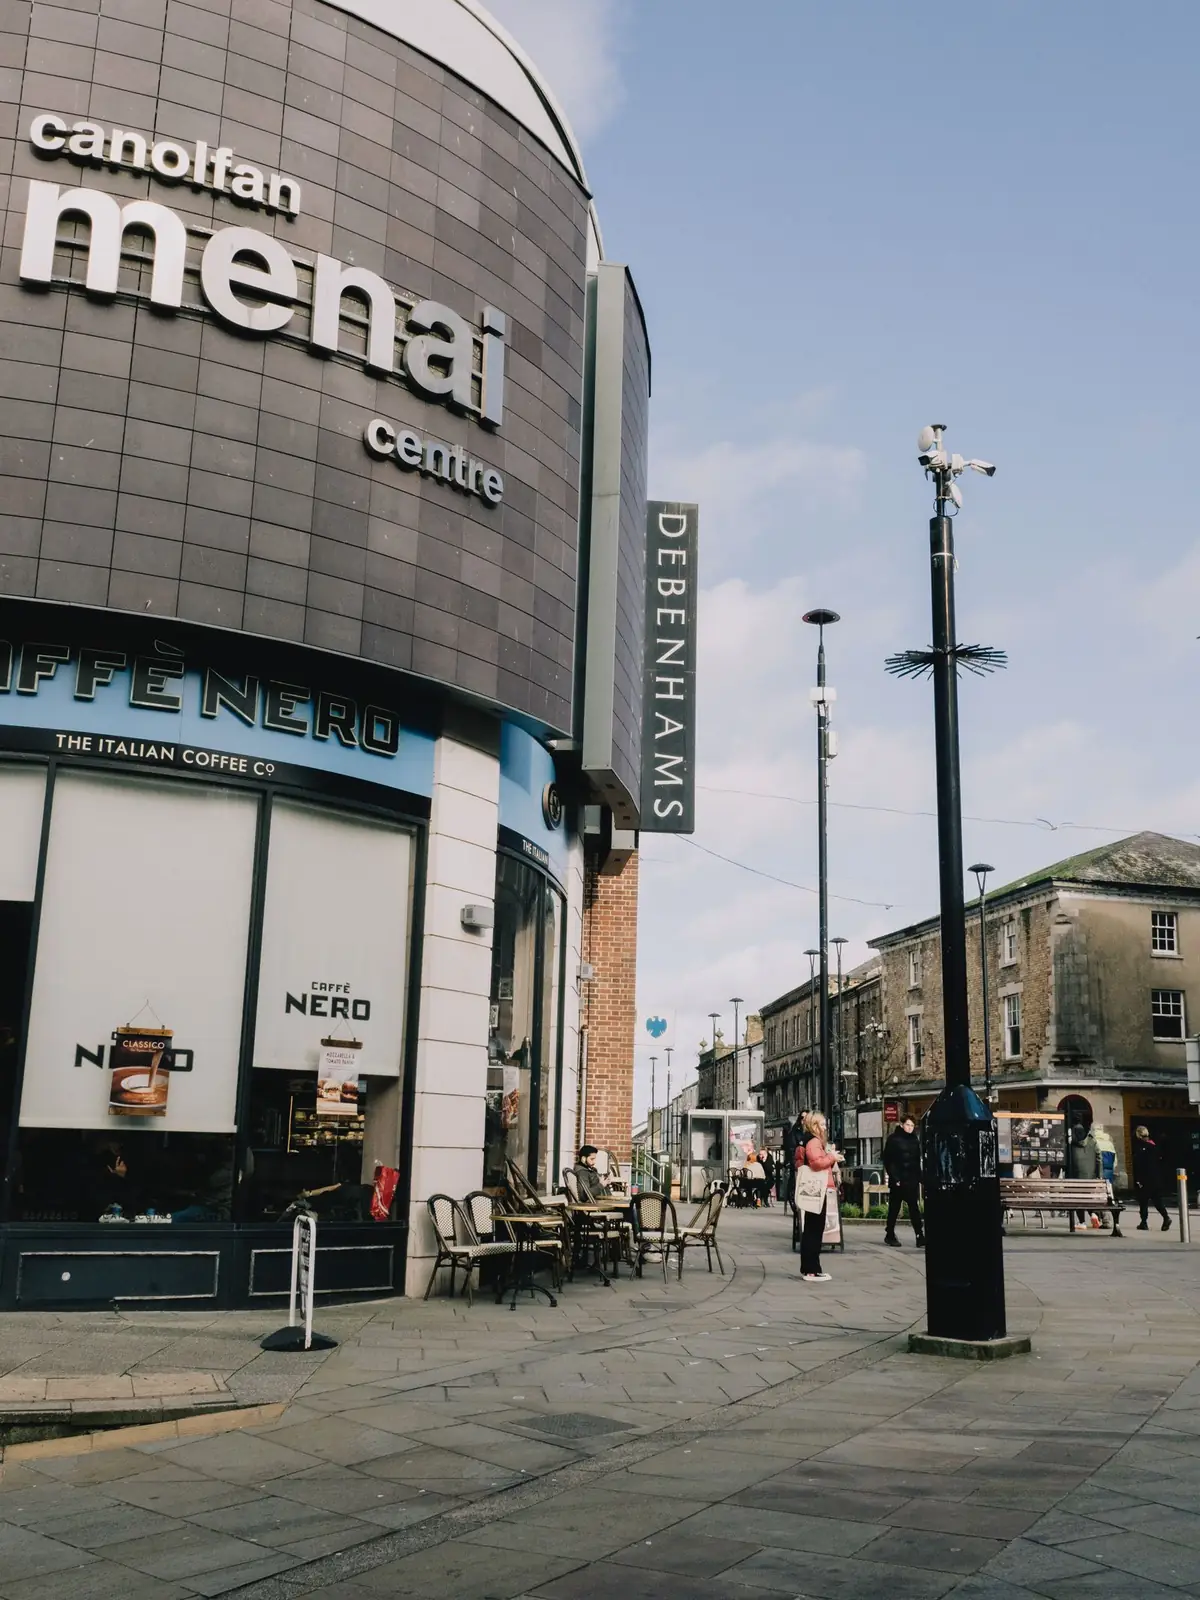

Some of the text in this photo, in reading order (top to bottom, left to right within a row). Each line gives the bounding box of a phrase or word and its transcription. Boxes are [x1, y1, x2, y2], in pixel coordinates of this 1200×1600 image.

[29, 114, 302, 217] canolfan
[19, 179, 506, 428] menai
[364, 418, 504, 503] centre
[652, 511, 687, 819] DEBENHAMS
[0, 638, 401, 757] FFÈ NERO
[56, 734, 92, 751] THE
[98, 738, 175, 761] ITALIAN
[182, 749, 248, 773] COFFEE
[285, 991, 371, 1021] NERO
[311, 981, 351, 994] CAFFÈ
[74, 1043, 194, 1072] NO
[123, 1039, 165, 1050] CLASSICO
